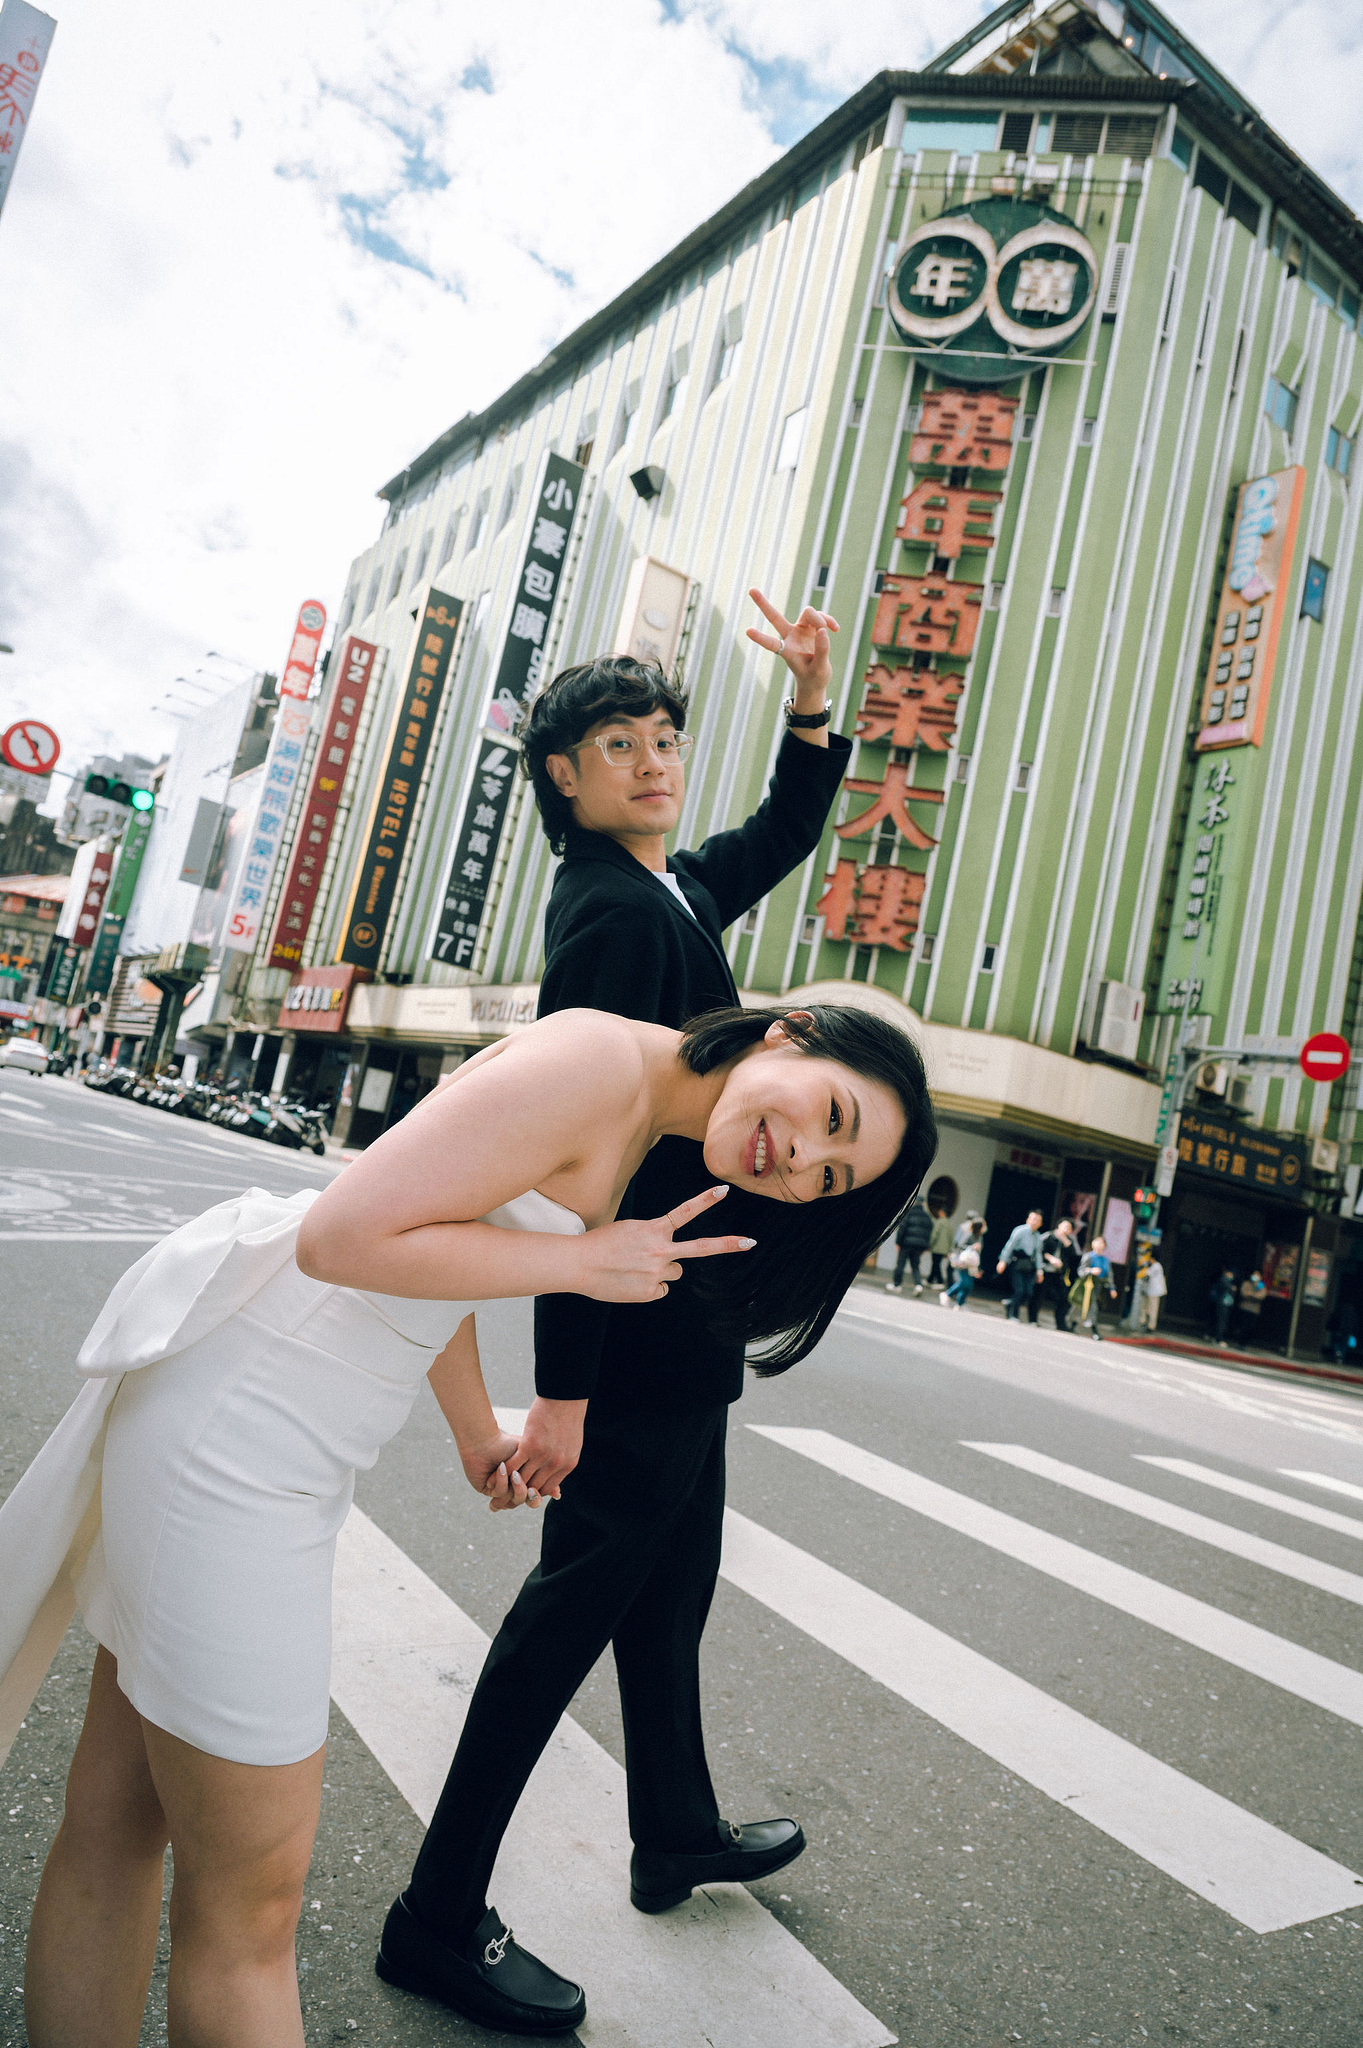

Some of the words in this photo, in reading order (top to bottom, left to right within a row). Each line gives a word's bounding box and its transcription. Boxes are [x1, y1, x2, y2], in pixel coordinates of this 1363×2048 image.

[816, 388, 1021, 952] 萬年商業大樓
[379, 778, 410, 840] HOTEL
[375, 844, 394, 861] 6
[437, 932, 474, 963] 7F
